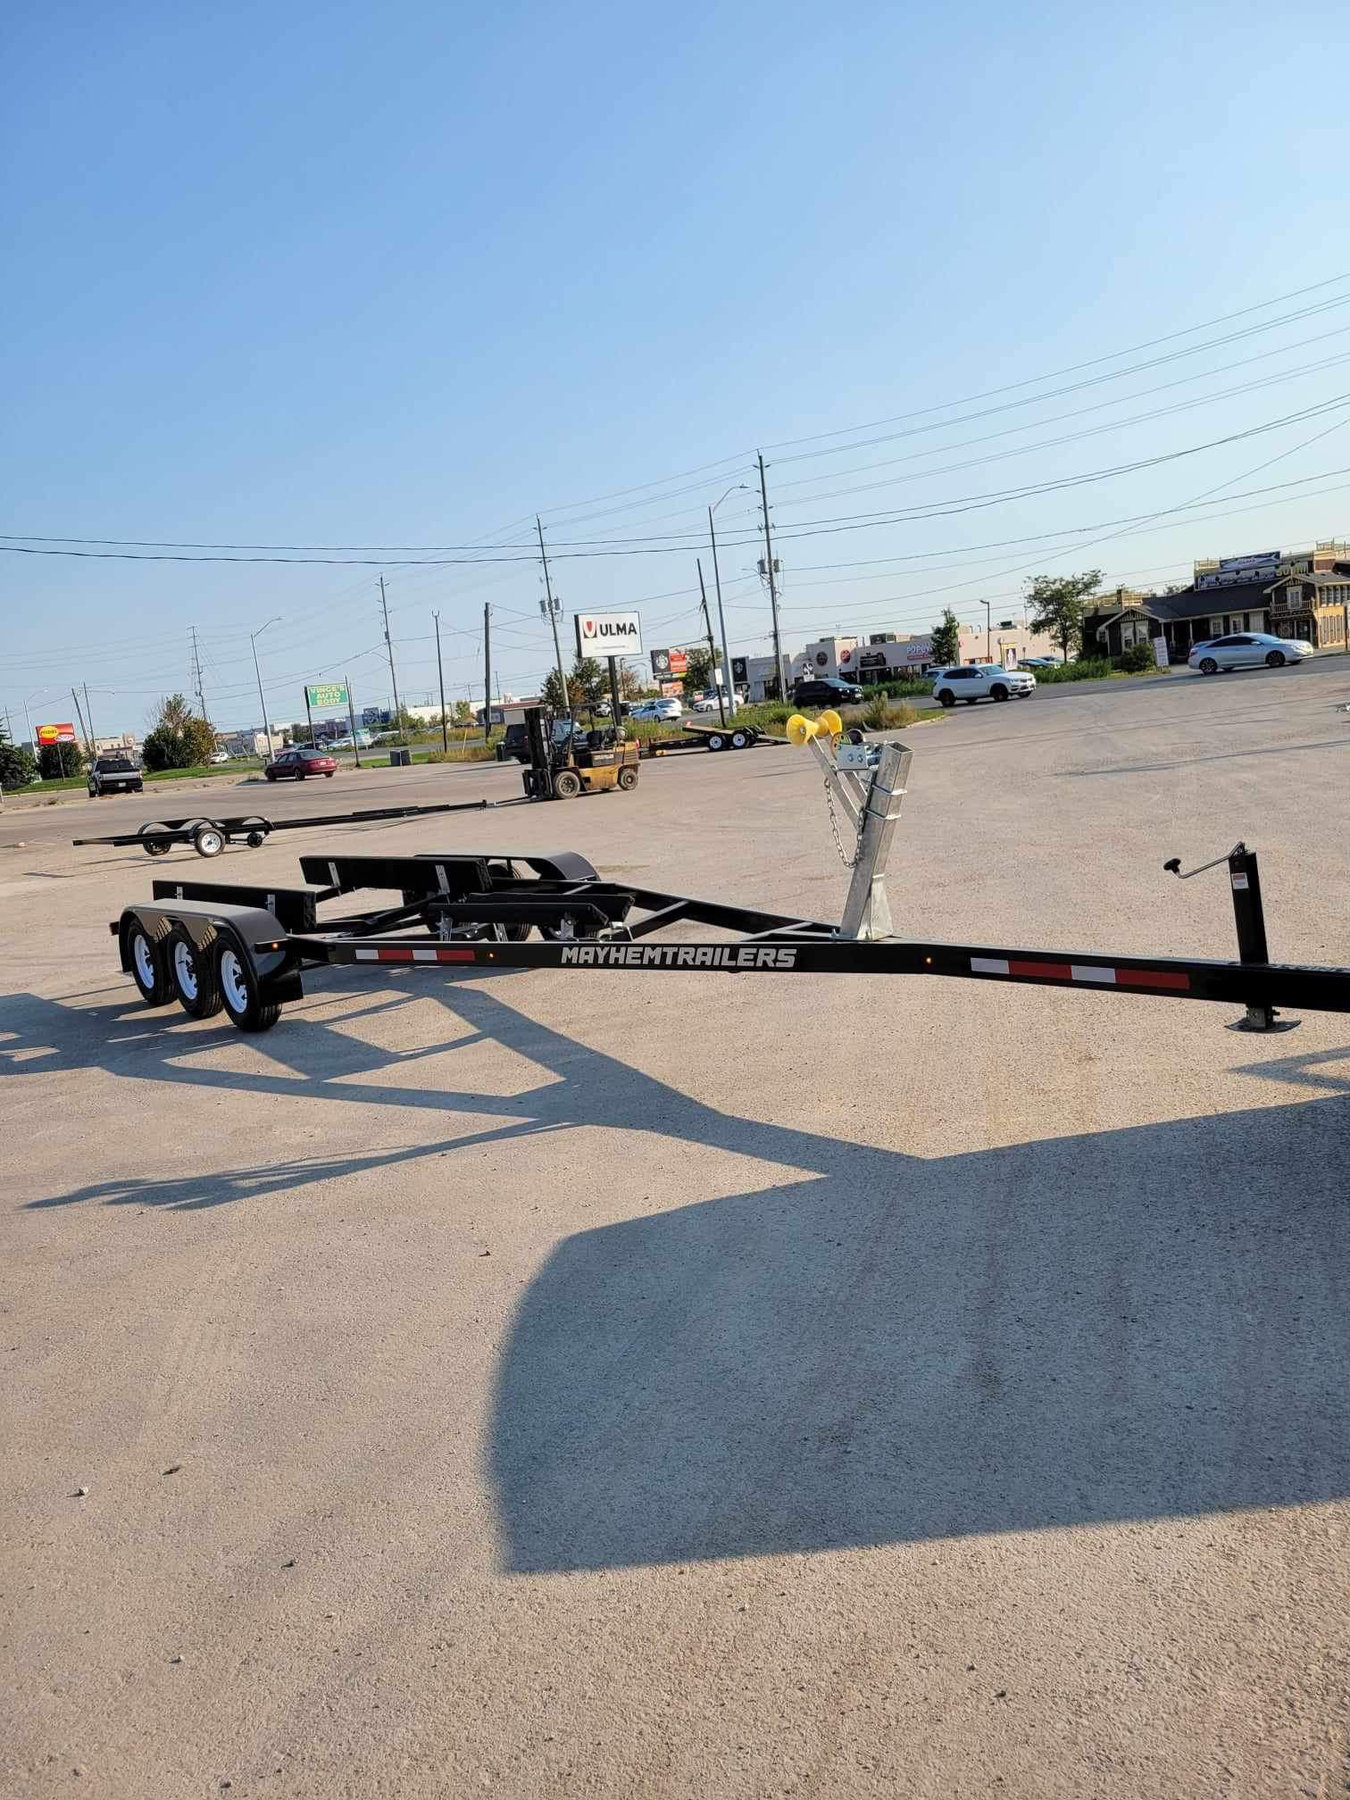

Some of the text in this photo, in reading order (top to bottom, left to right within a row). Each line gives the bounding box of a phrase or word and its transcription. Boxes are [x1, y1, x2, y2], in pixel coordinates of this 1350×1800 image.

[599, 622, 637, 636] ULMA
[316, 691, 340, 699] AUTO
[316, 697, 339, 705] BODY
[561, 947, 797, 968] MAYHEMTRAILERS
